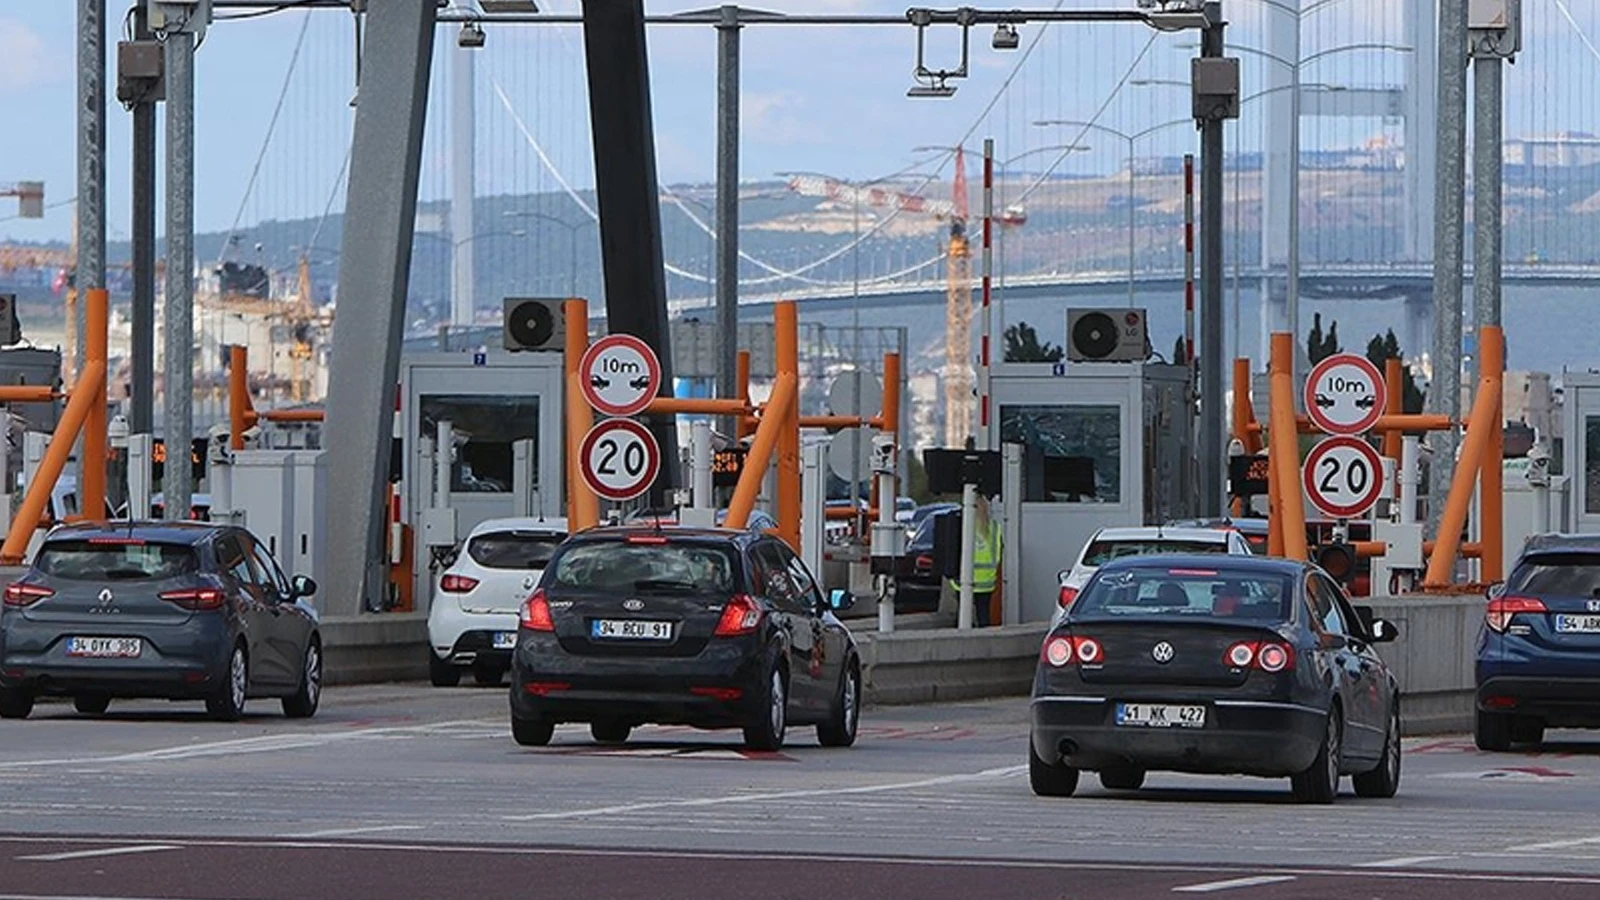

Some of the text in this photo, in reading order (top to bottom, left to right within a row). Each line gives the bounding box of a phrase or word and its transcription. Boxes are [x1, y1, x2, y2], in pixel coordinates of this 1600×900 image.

[1125, 328, 1138, 337] LG
[603, 358, 639, 373] 10m
[1328, 377, 1365, 392] 10m
[597, 440, 645, 476] 20
[1320, 457, 1367, 494] 20
[601, 621, 614, 634] 34
[653, 623, 667, 636] 91
[1564, 617, 1577, 629] 54
[73, 639, 86, 651] 34
[1125, 705, 1203, 721] 41 NK 427
